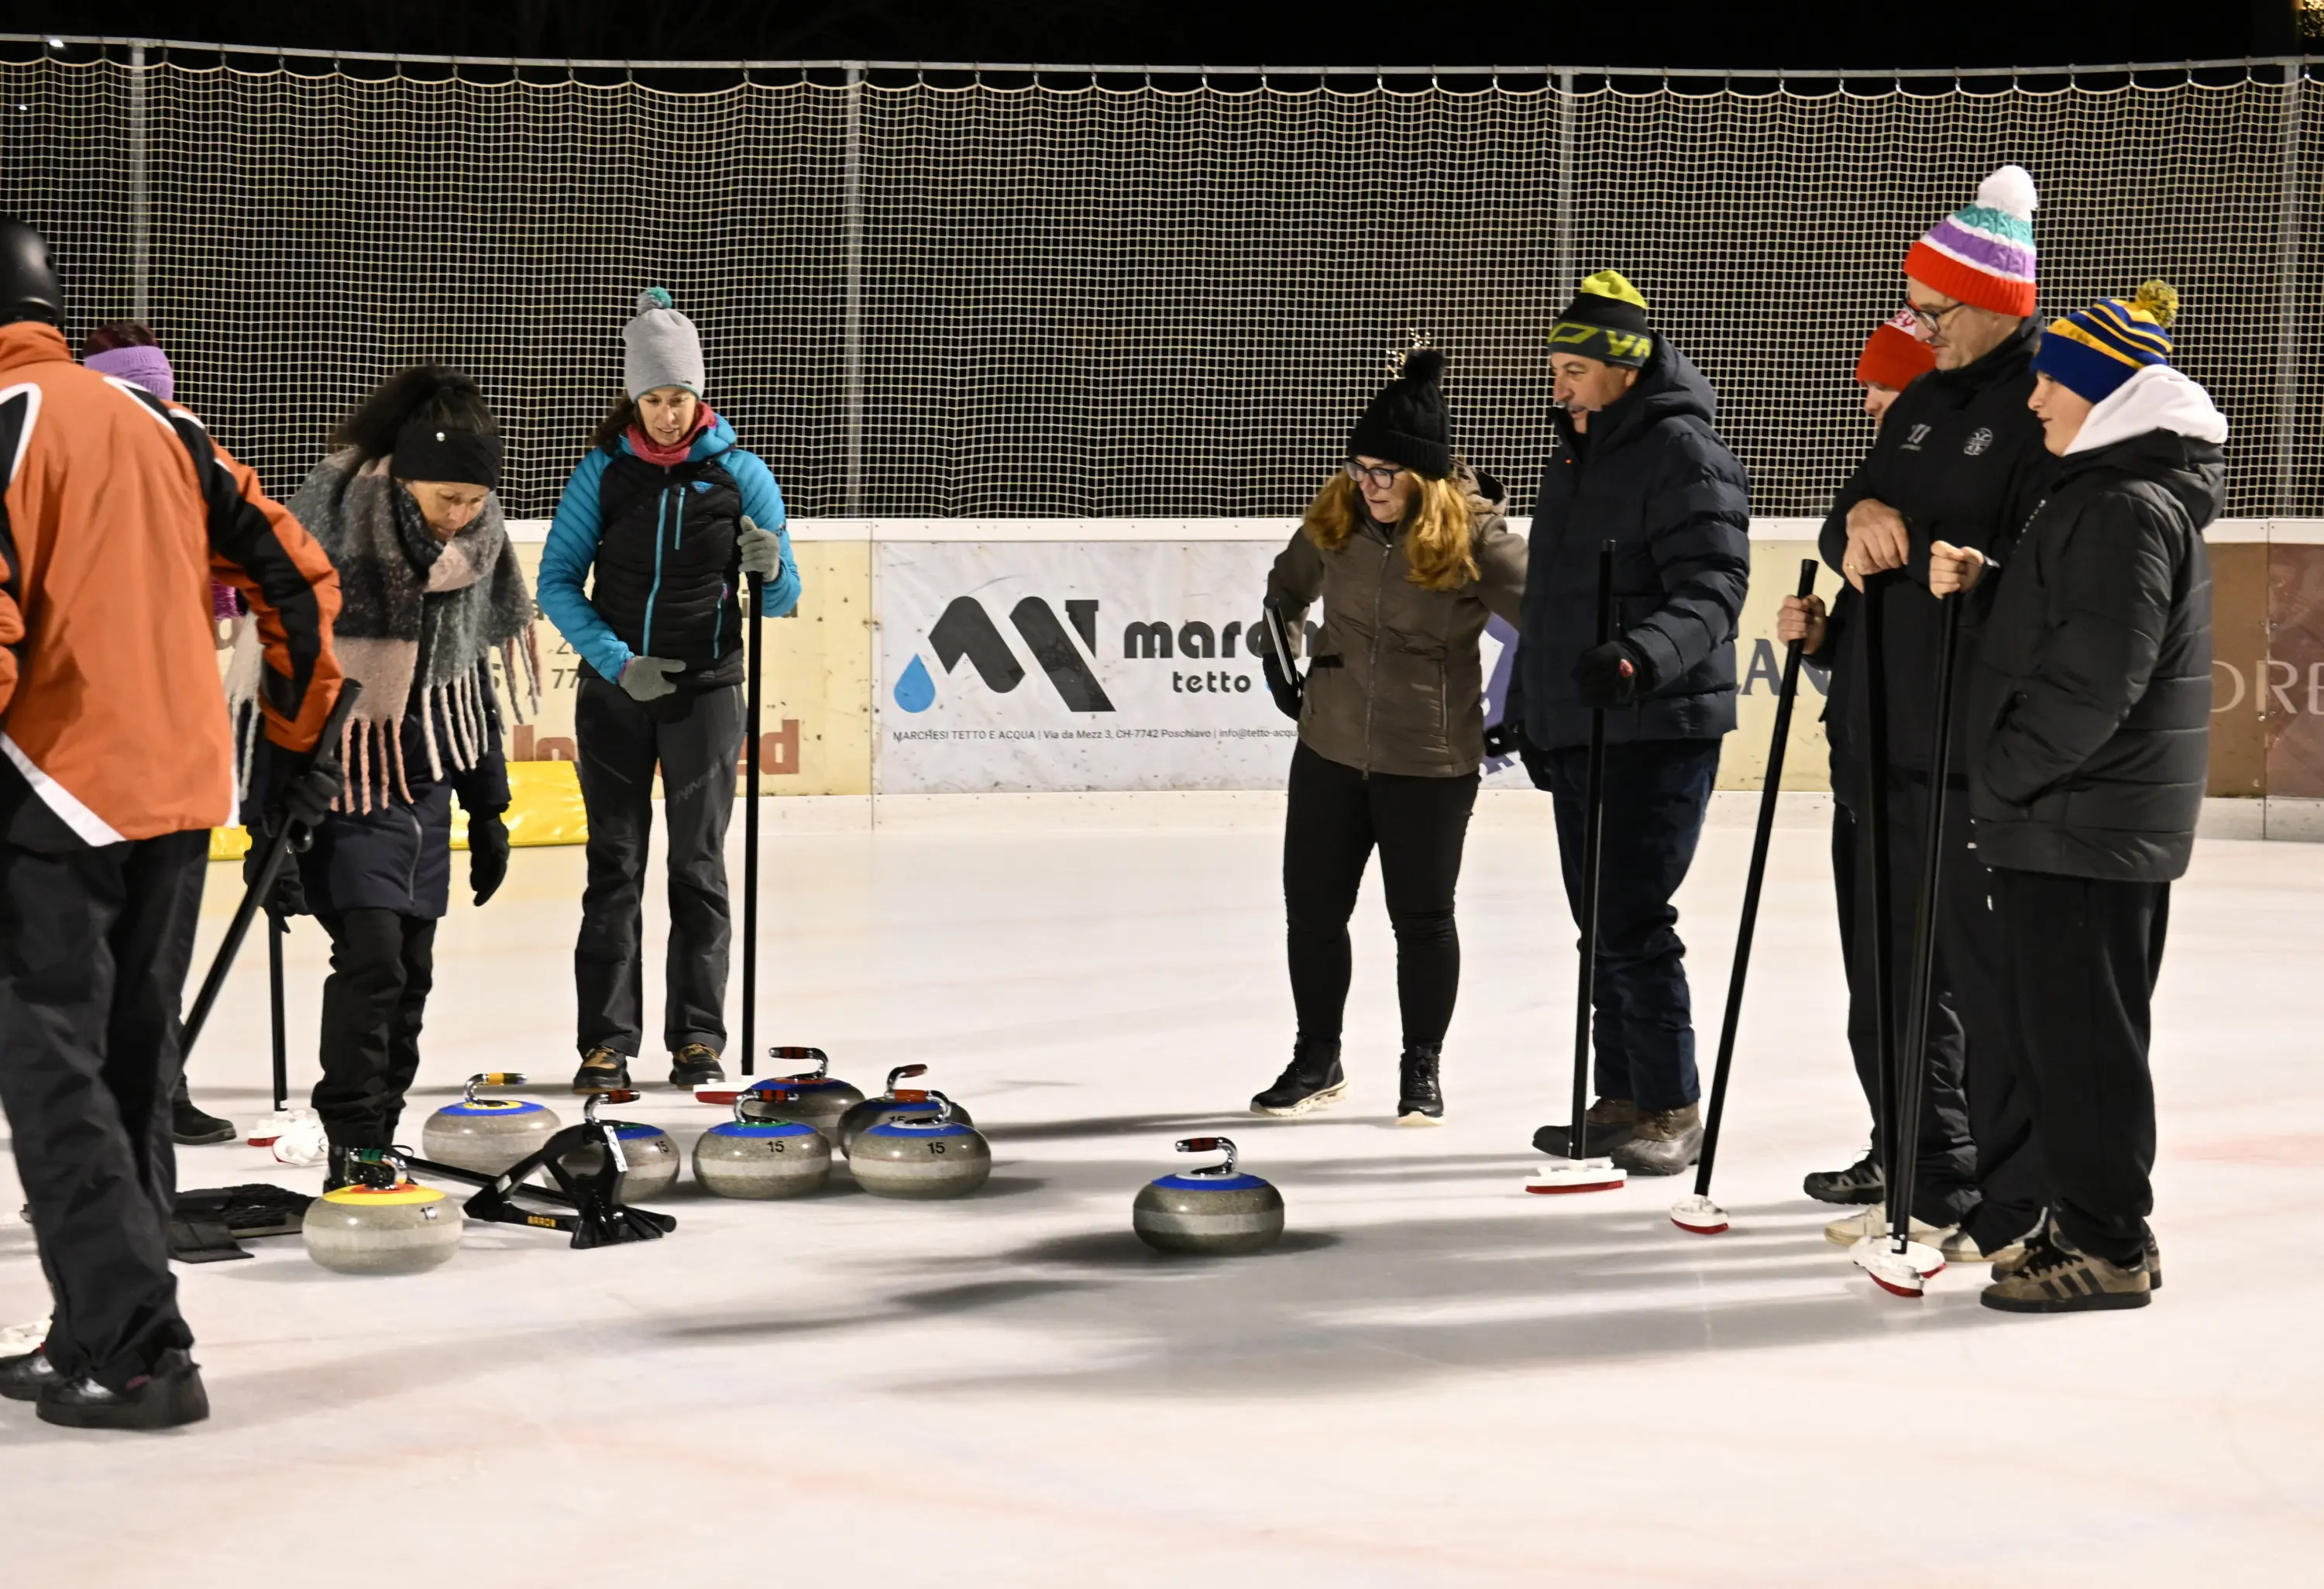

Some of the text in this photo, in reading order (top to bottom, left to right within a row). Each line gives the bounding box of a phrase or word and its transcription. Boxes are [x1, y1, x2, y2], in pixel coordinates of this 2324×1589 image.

[1173, 671, 1251, 693] tetto
[893, 731, 948, 741] MARCHESI
[952, 731, 986, 740] TETTO
[989, 731, 996, 740] E
[999, 731, 1035, 741] ACQUA
[1043, 730, 1059, 739] Via
[1062, 730, 1073, 739] da
[1077, 729, 1102, 739] Mezz
[1116, 729, 1158, 739] CH-7742
[1162, 728, 1212, 738] Poschiavo
[767, 1140, 784, 1153] 15
[927, 1141, 945, 1154] 15
